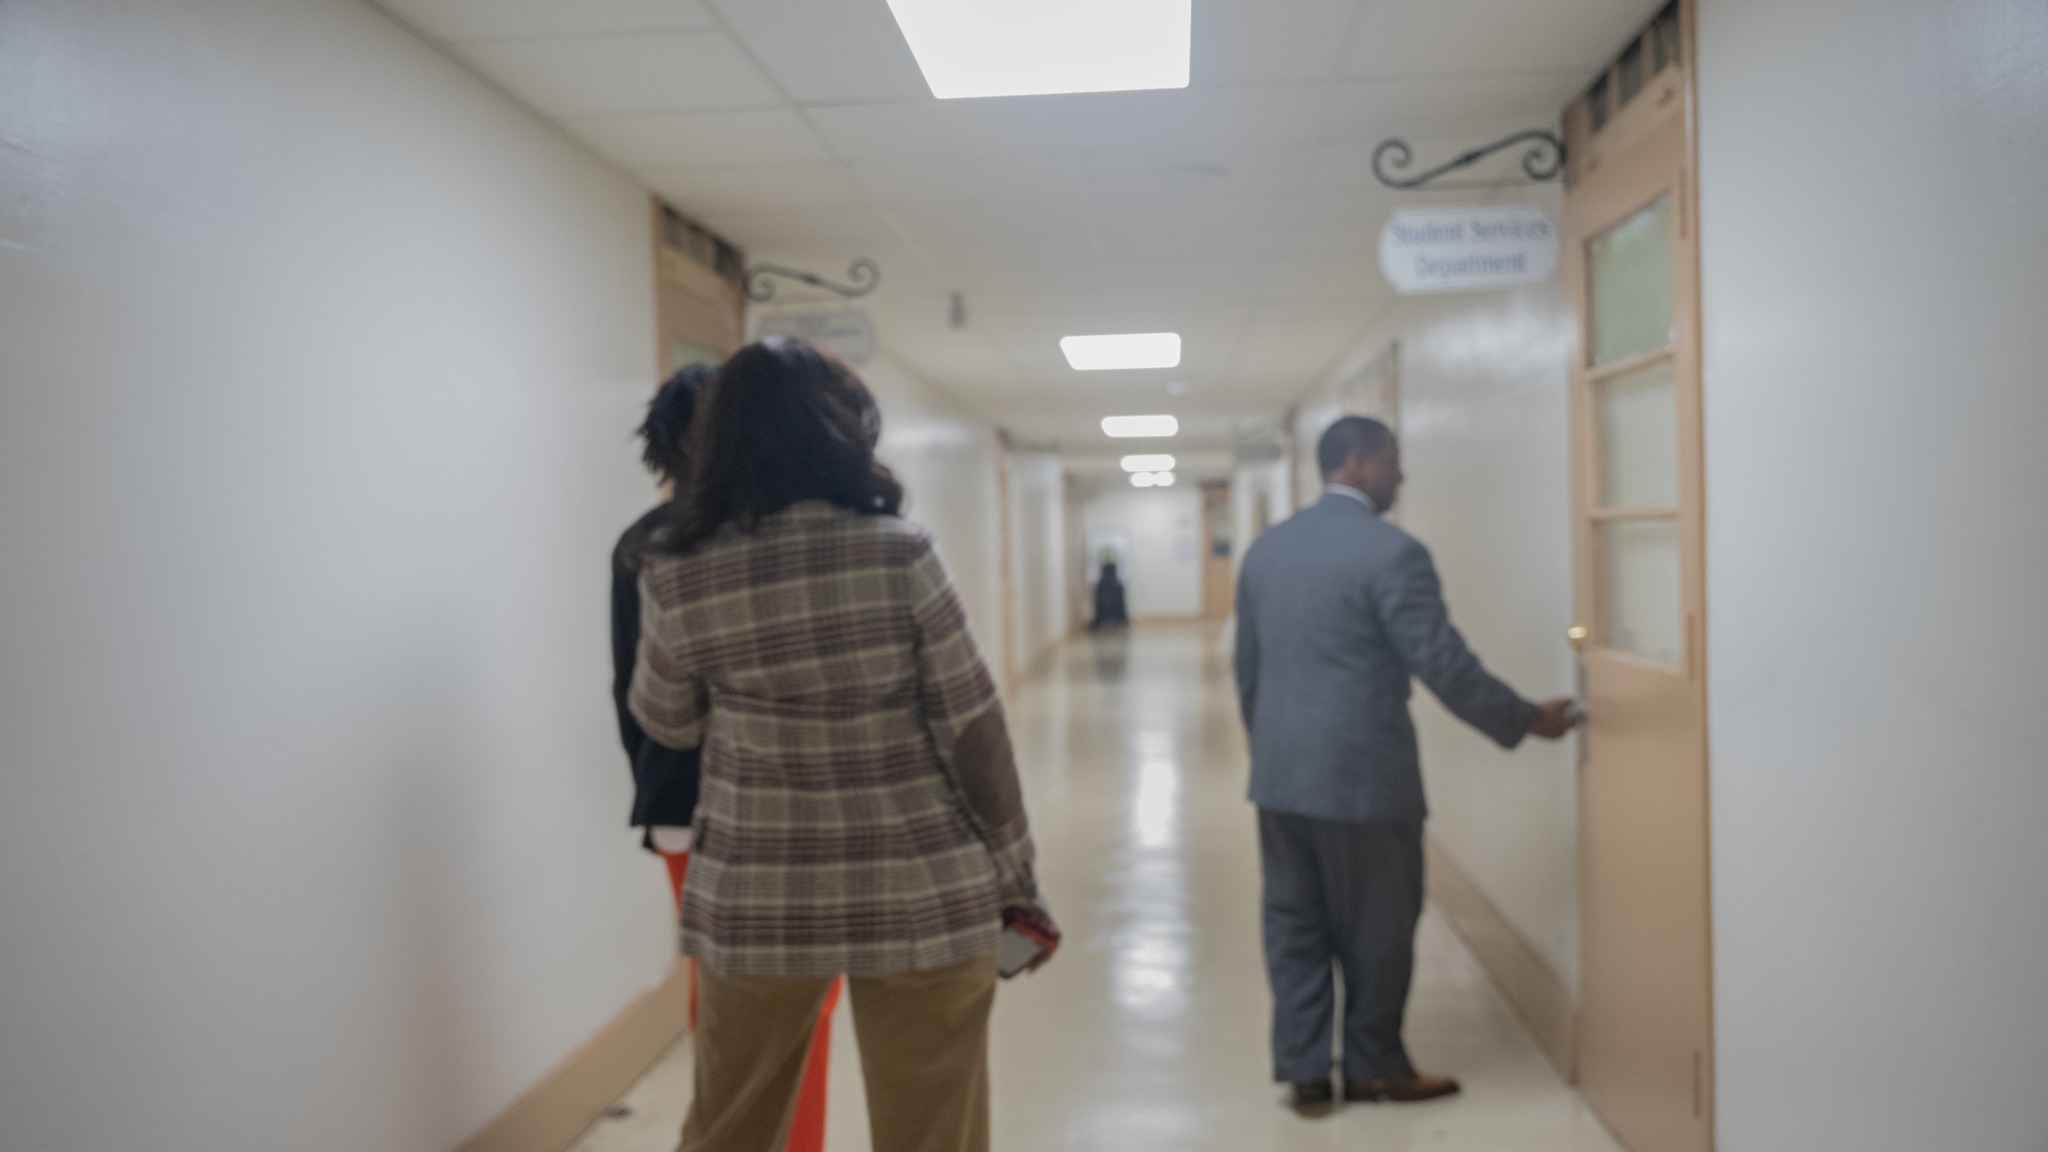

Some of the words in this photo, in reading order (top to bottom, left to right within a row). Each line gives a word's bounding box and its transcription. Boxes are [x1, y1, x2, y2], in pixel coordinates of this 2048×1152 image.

[1390, 219, 1464, 246] Student
[1469, 217, 1551, 243] Services
[1415, 253, 1526, 281] Department
